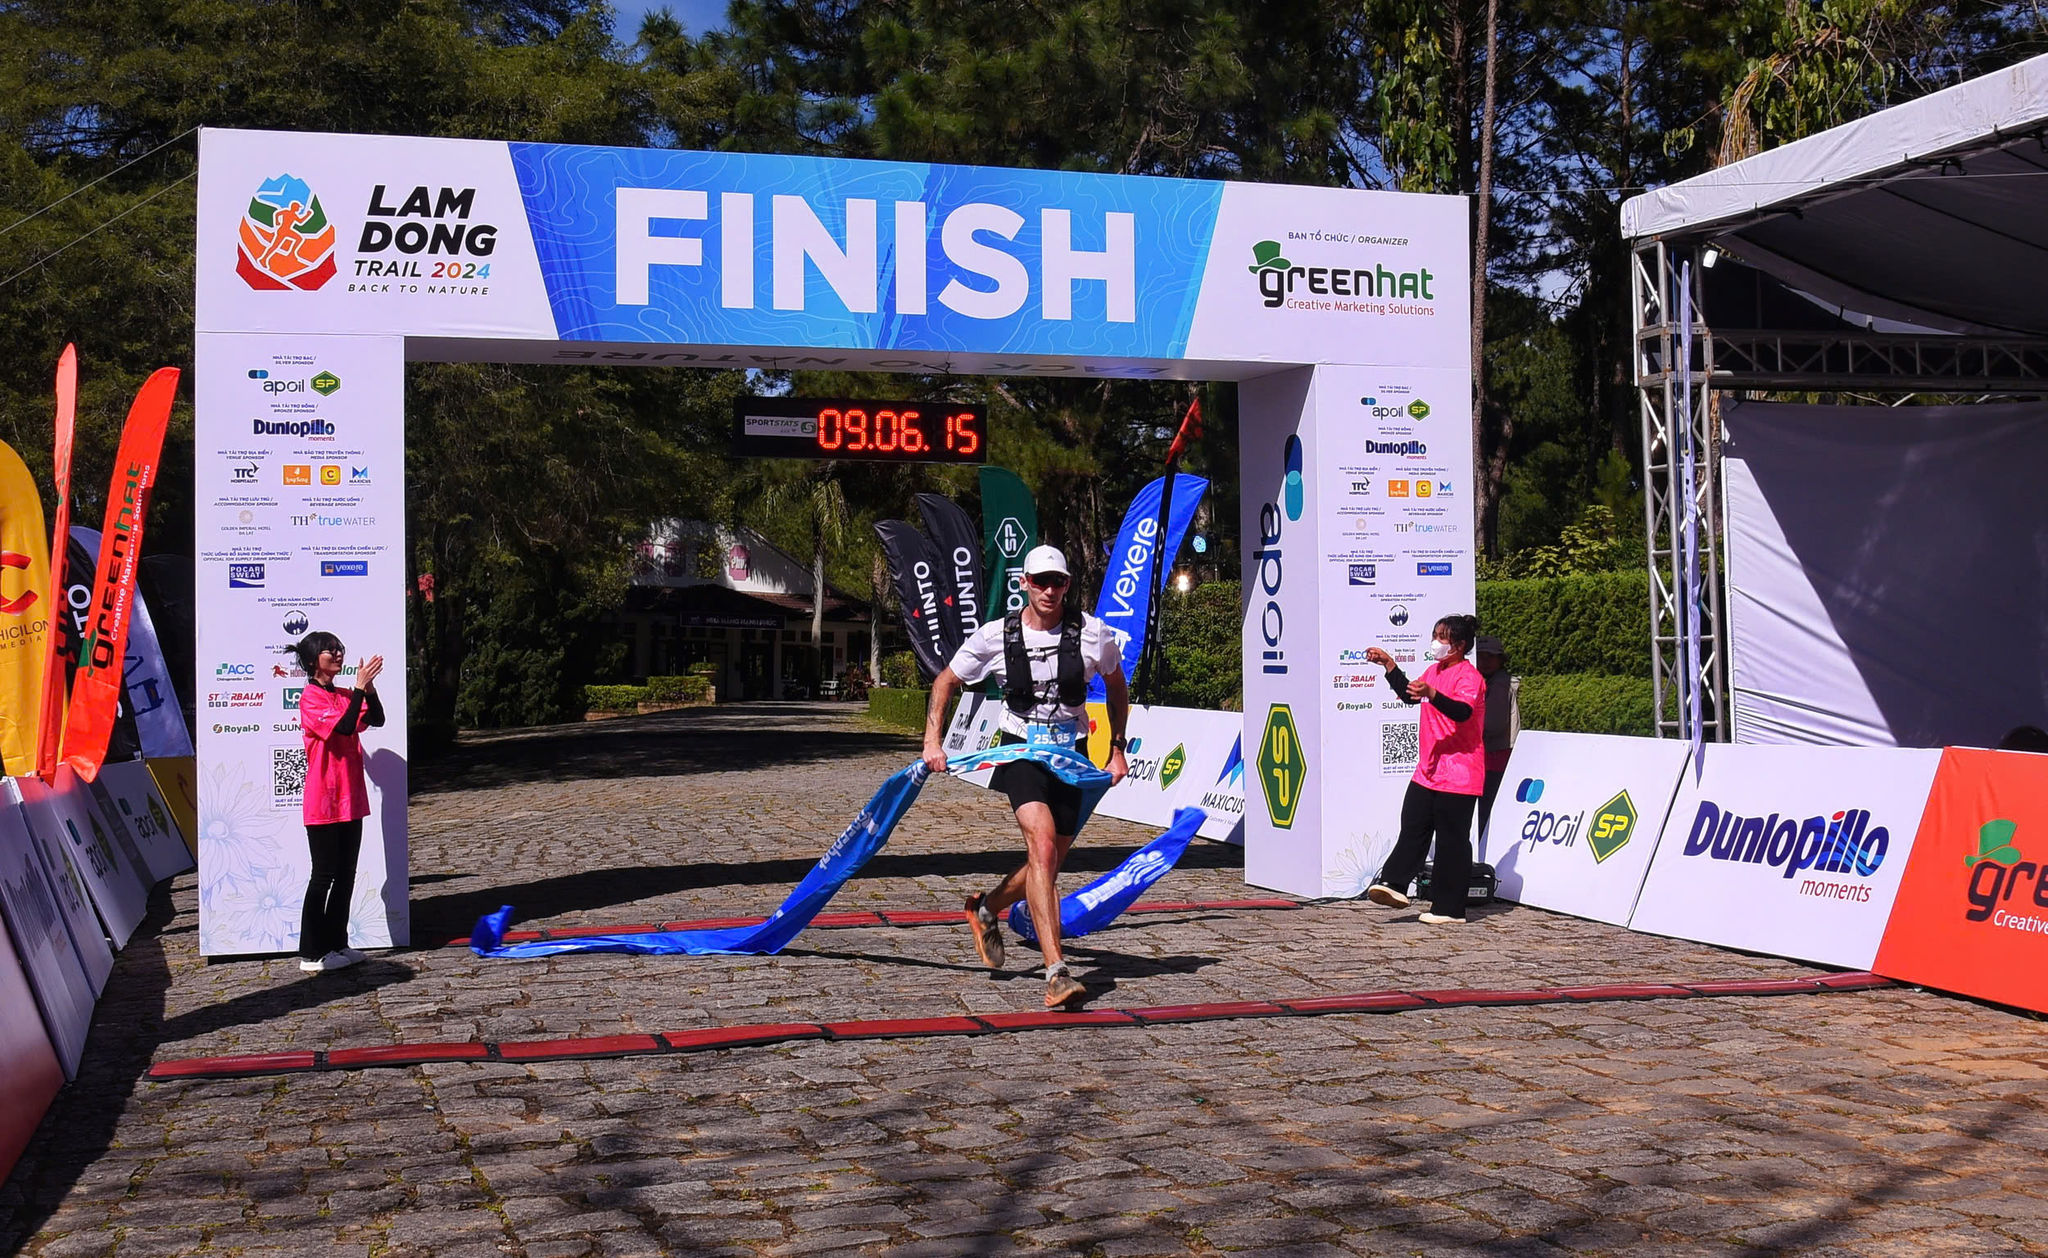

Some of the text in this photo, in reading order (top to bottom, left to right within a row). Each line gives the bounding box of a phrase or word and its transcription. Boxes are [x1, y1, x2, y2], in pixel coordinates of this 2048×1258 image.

[367, 185, 476, 219] LAM
[357, 221, 498, 257] DONG
[1288, 231, 1307, 240] BAN
[1309, 229, 1322, 241] TỔ
[1324, 231, 1349, 243] CHỨC
[1358, 235, 1408, 246] ORGANIZER
[615, 187, 1136, 323] FINISH
[354, 260, 491, 279] TRAIL 2024
[348, 284, 489, 295] BACK TO NATURE
[1286, 298, 1435, 316] Creative Marketing Solutions
[263, 379, 304, 396] apoil
[315, 379, 335, 388] SP
[1372, 405, 1403, 421] apoil
[1411, 406, 1427, 415] SP
[253, 418, 335, 438] Dunlopillo
[745, 418, 799, 428] SPORTSTATS
[1365, 440, 1427, 456] Dunlopillo
[234, 468, 255, 478] TTC
[290, 516, 309, 526] TH
[1005, 523, 1017, 552] SP
[1105, 517, 1158, 617] Vexere
[1252, 502, 1289, 675] apoil
[111, 587, 127, 641] Creative
[227, 664, 255, 675] ACC
[1345, 702, 1373, 711] Royal-D
[224, 724, 260, 734] Royal-D
[273, 724, 301, 733] SUUN
[1127, 757, 1161, 787] apoil
[1163, 758, 1182, 775] SP
[1272, 724, 1290, 807] SP
[1200, 791, 1245, 814] MAXICUS
[1521, 810, 1585, 853] apoil
[1594, 813, 1629, 839] SP
[1682, 800, 1890, 880] Dunlopillo
[1799, 879, 1873, 903] moments
